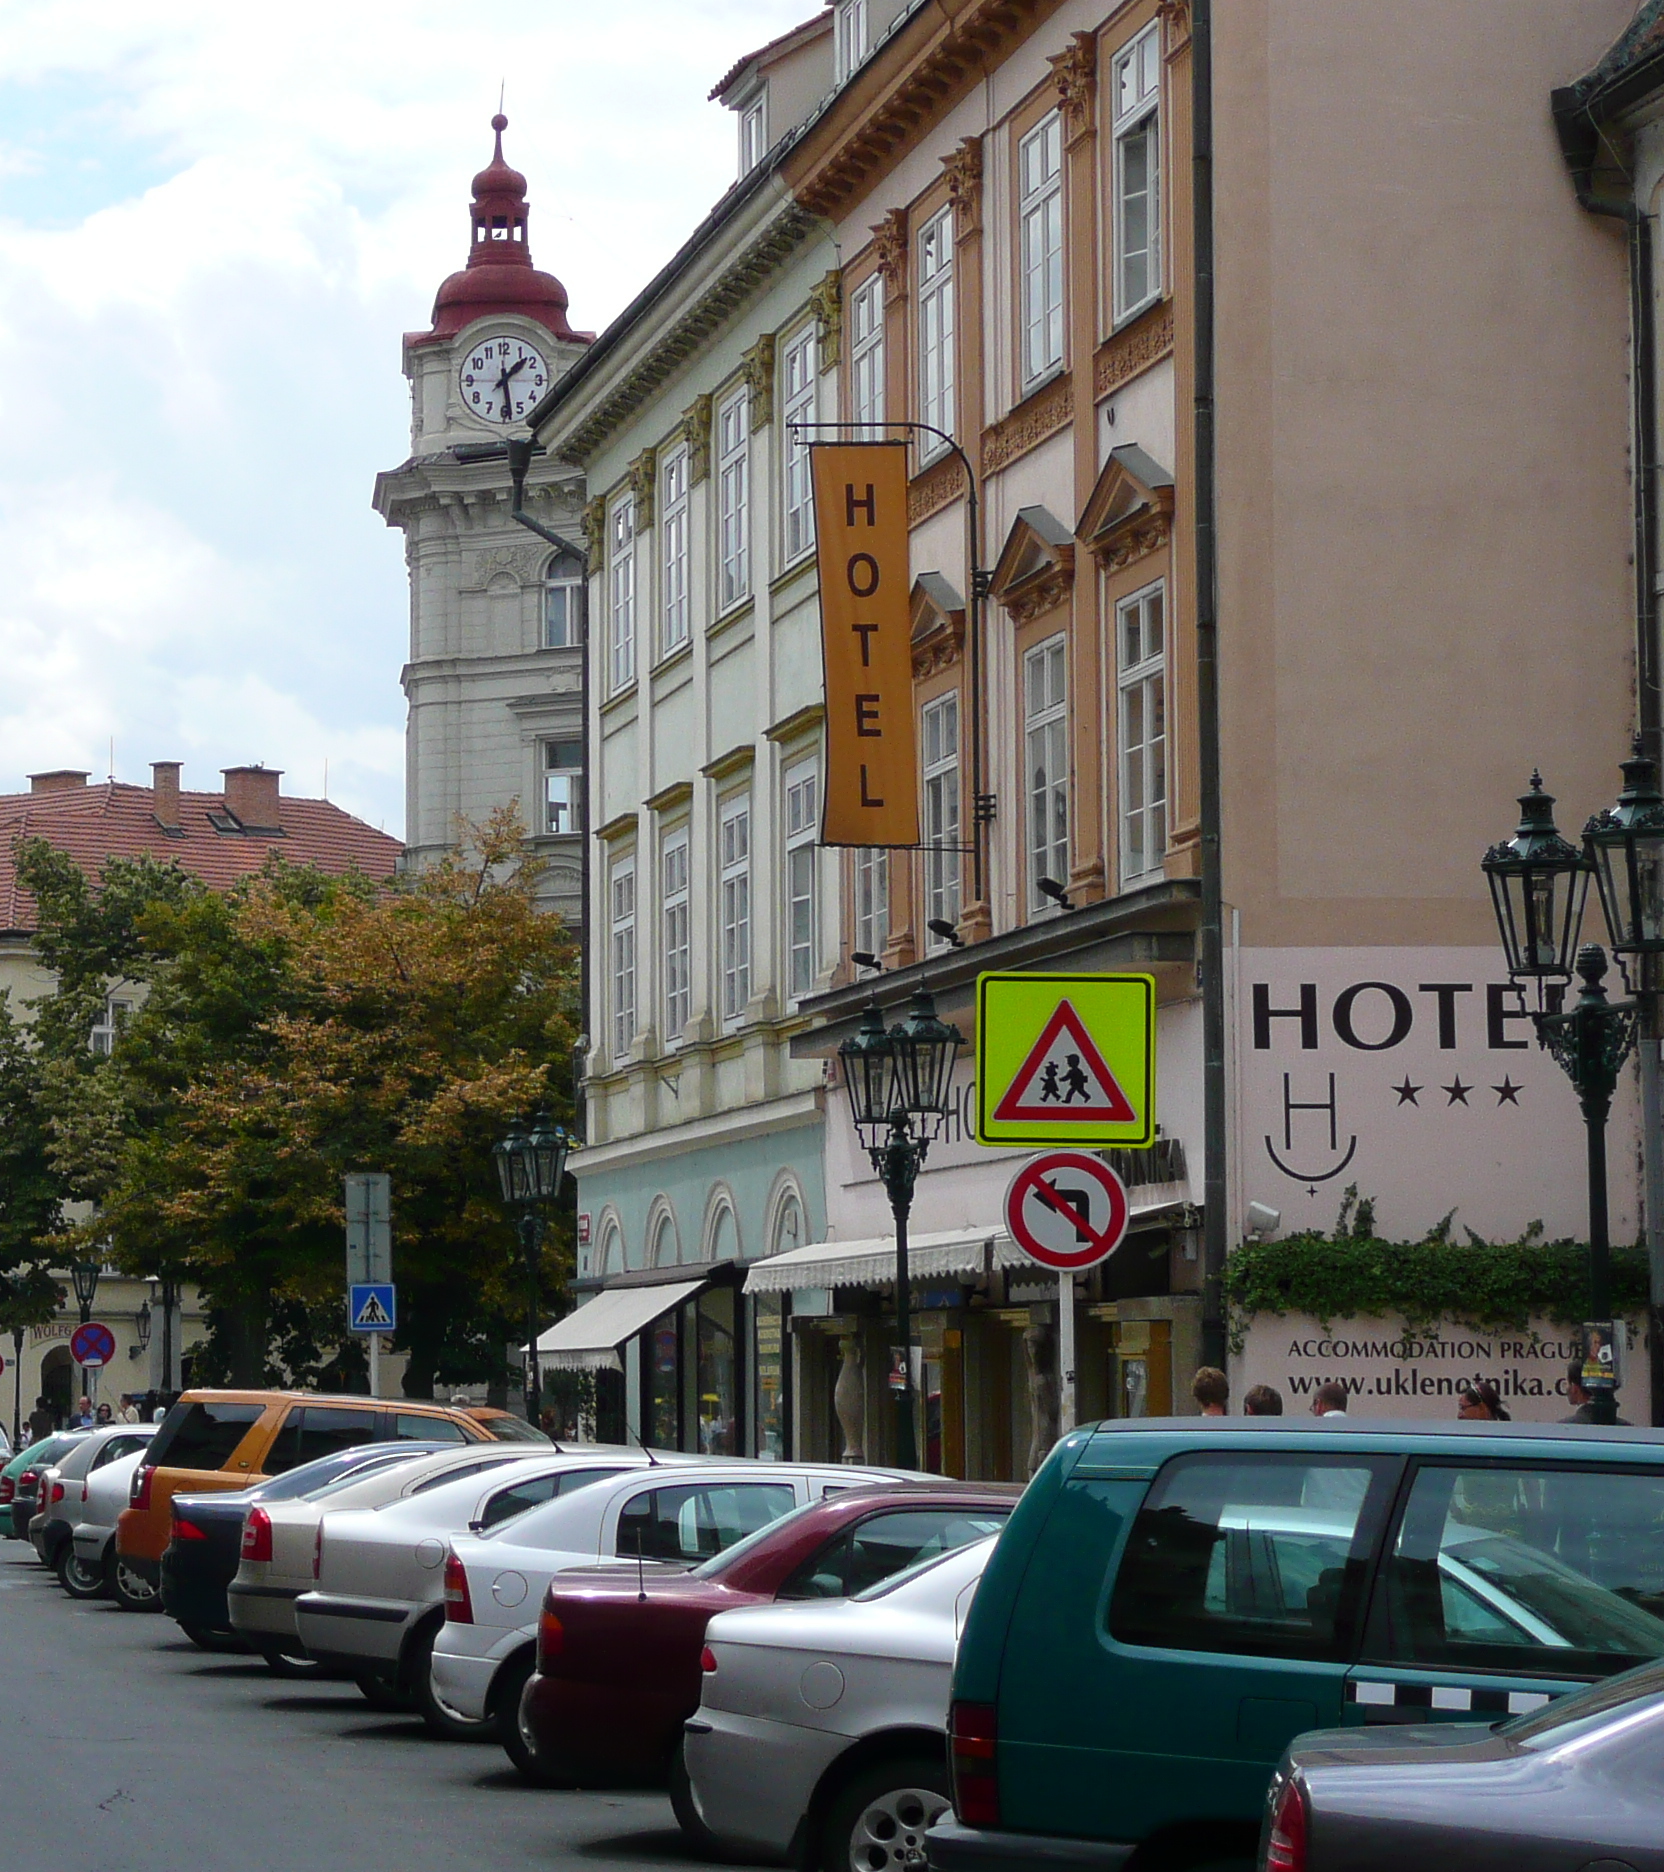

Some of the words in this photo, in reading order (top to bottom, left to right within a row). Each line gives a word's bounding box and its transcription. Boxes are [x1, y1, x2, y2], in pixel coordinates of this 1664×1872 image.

[484, 346, 493, 360] 11
[498, 342, 510, 356] 12
[517, 346, 522, 359] 1
[472, 357, 484, 371] 10
[528, 356, 537, 369] 2
[465, 374, 474, 387] 9
[534, 374, 543, 387] 3
[472, 391, 481, 404] 8
[528, 390, 537, 403] 4
[485, 401, 493, 414] 7
[515, 401, 524, 414] 5
[845, 483, 885, 808] HOTEL
[33, 1324, 77, 1339] WOLFG
[1287, 1340, 1492, 1359] ACCOMMODATION
